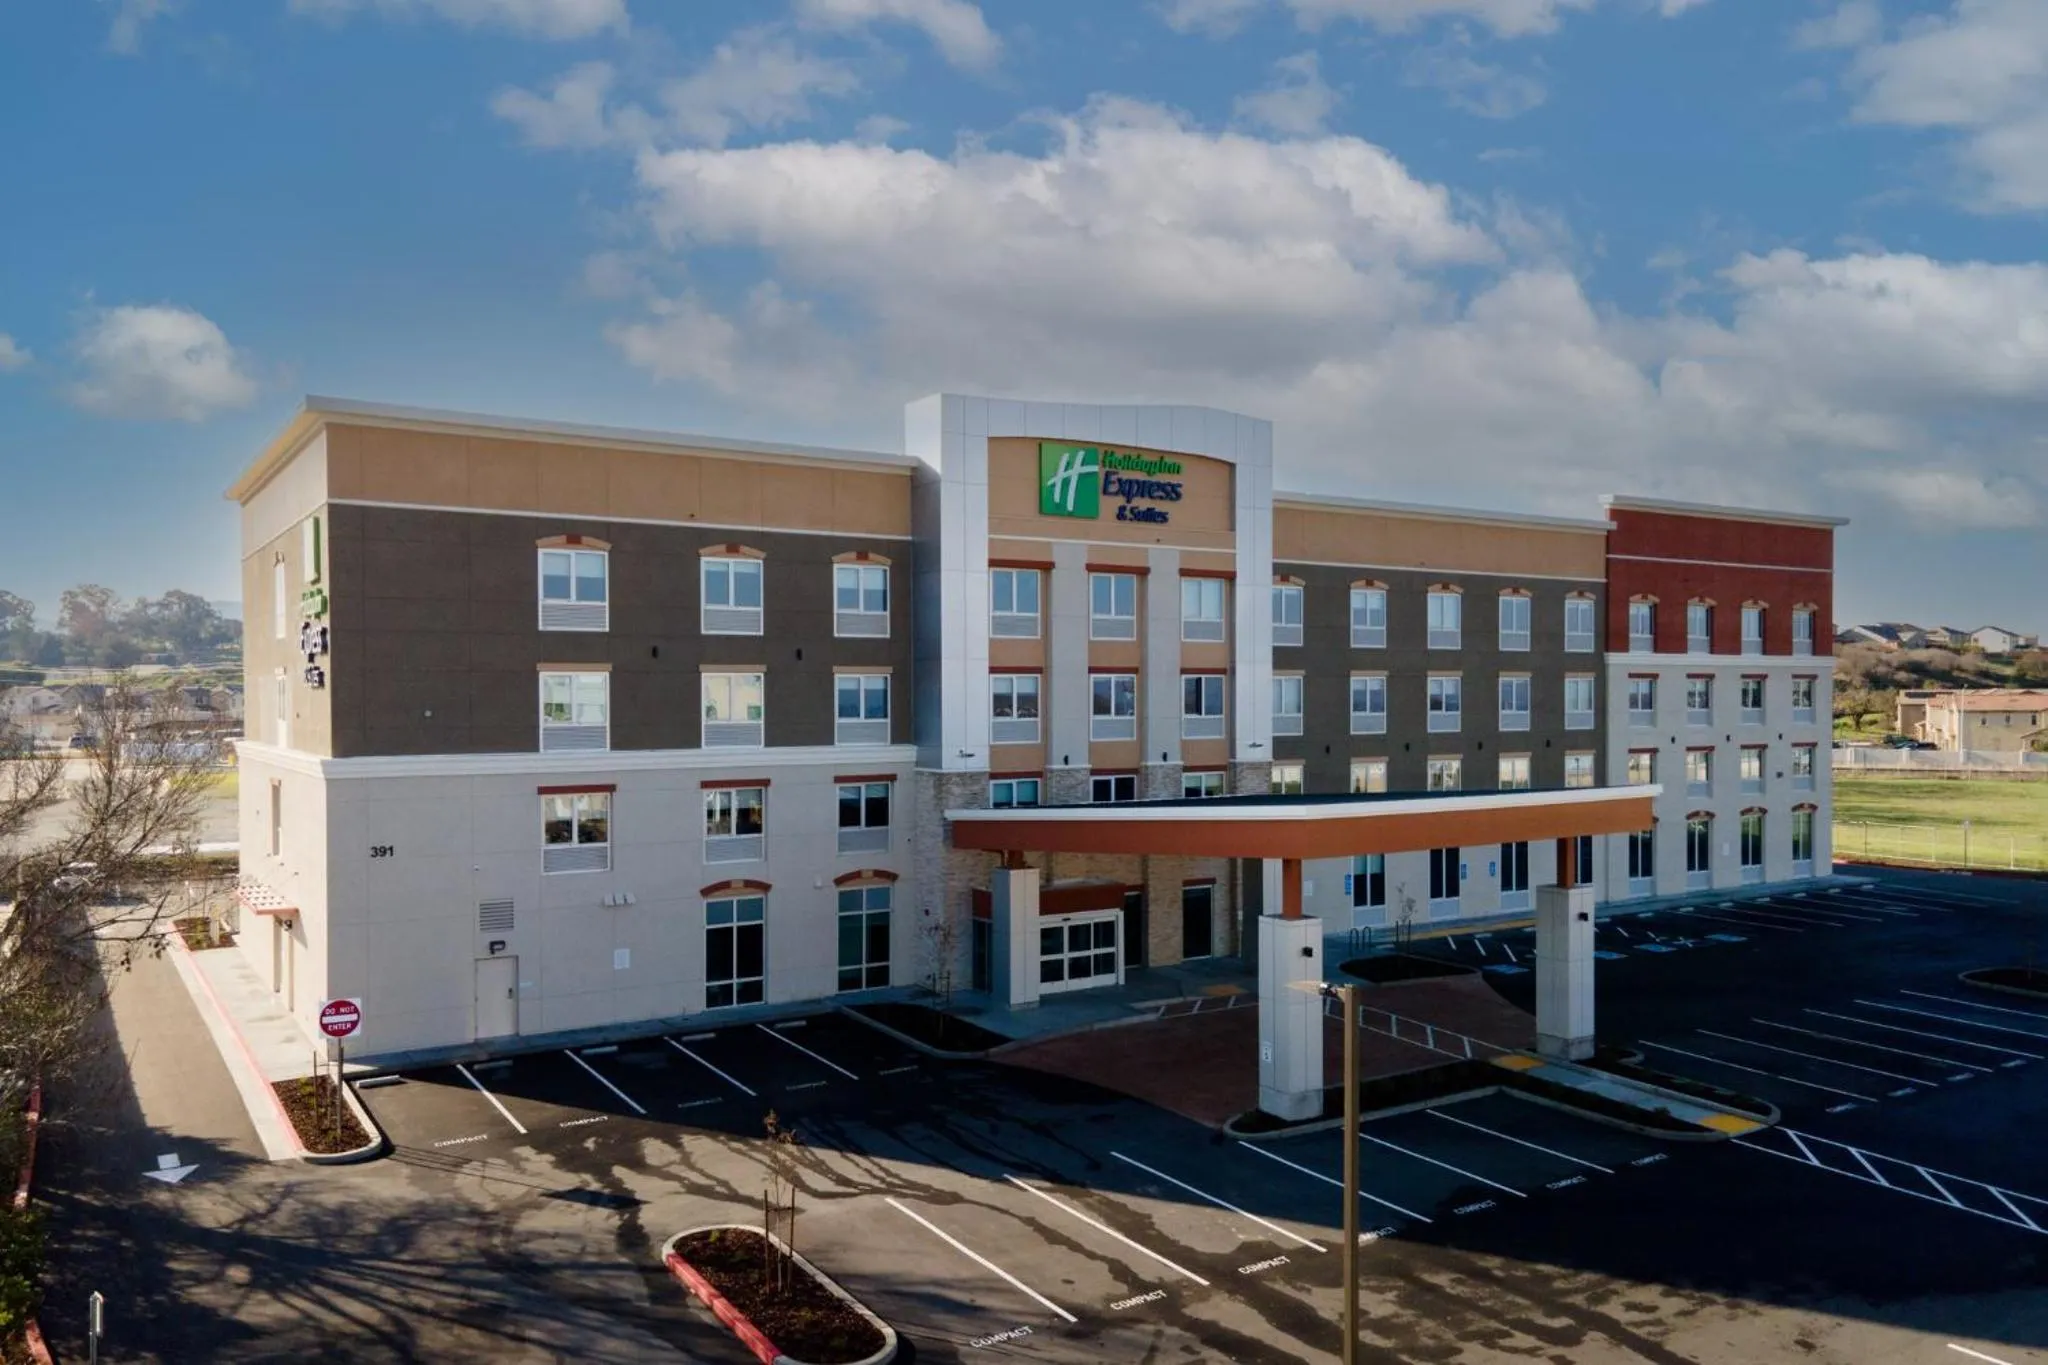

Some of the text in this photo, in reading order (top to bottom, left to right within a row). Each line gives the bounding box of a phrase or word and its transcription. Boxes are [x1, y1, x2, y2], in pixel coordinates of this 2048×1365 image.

[1102, 470, 1183, 504] Express
[1115, 505, 1169, 523] & Suites
[370, 845, 394, 858] 391
[325, 1005, 355, 1015] DO NOT
[328, 1023, 352, 1031] ENTER
[1237, 1255, 1291, 1275] COMPACT
[1109, 1289, 1168, 1311] COMPACT
[969, 1325, 1033, 1348] COMPACT
